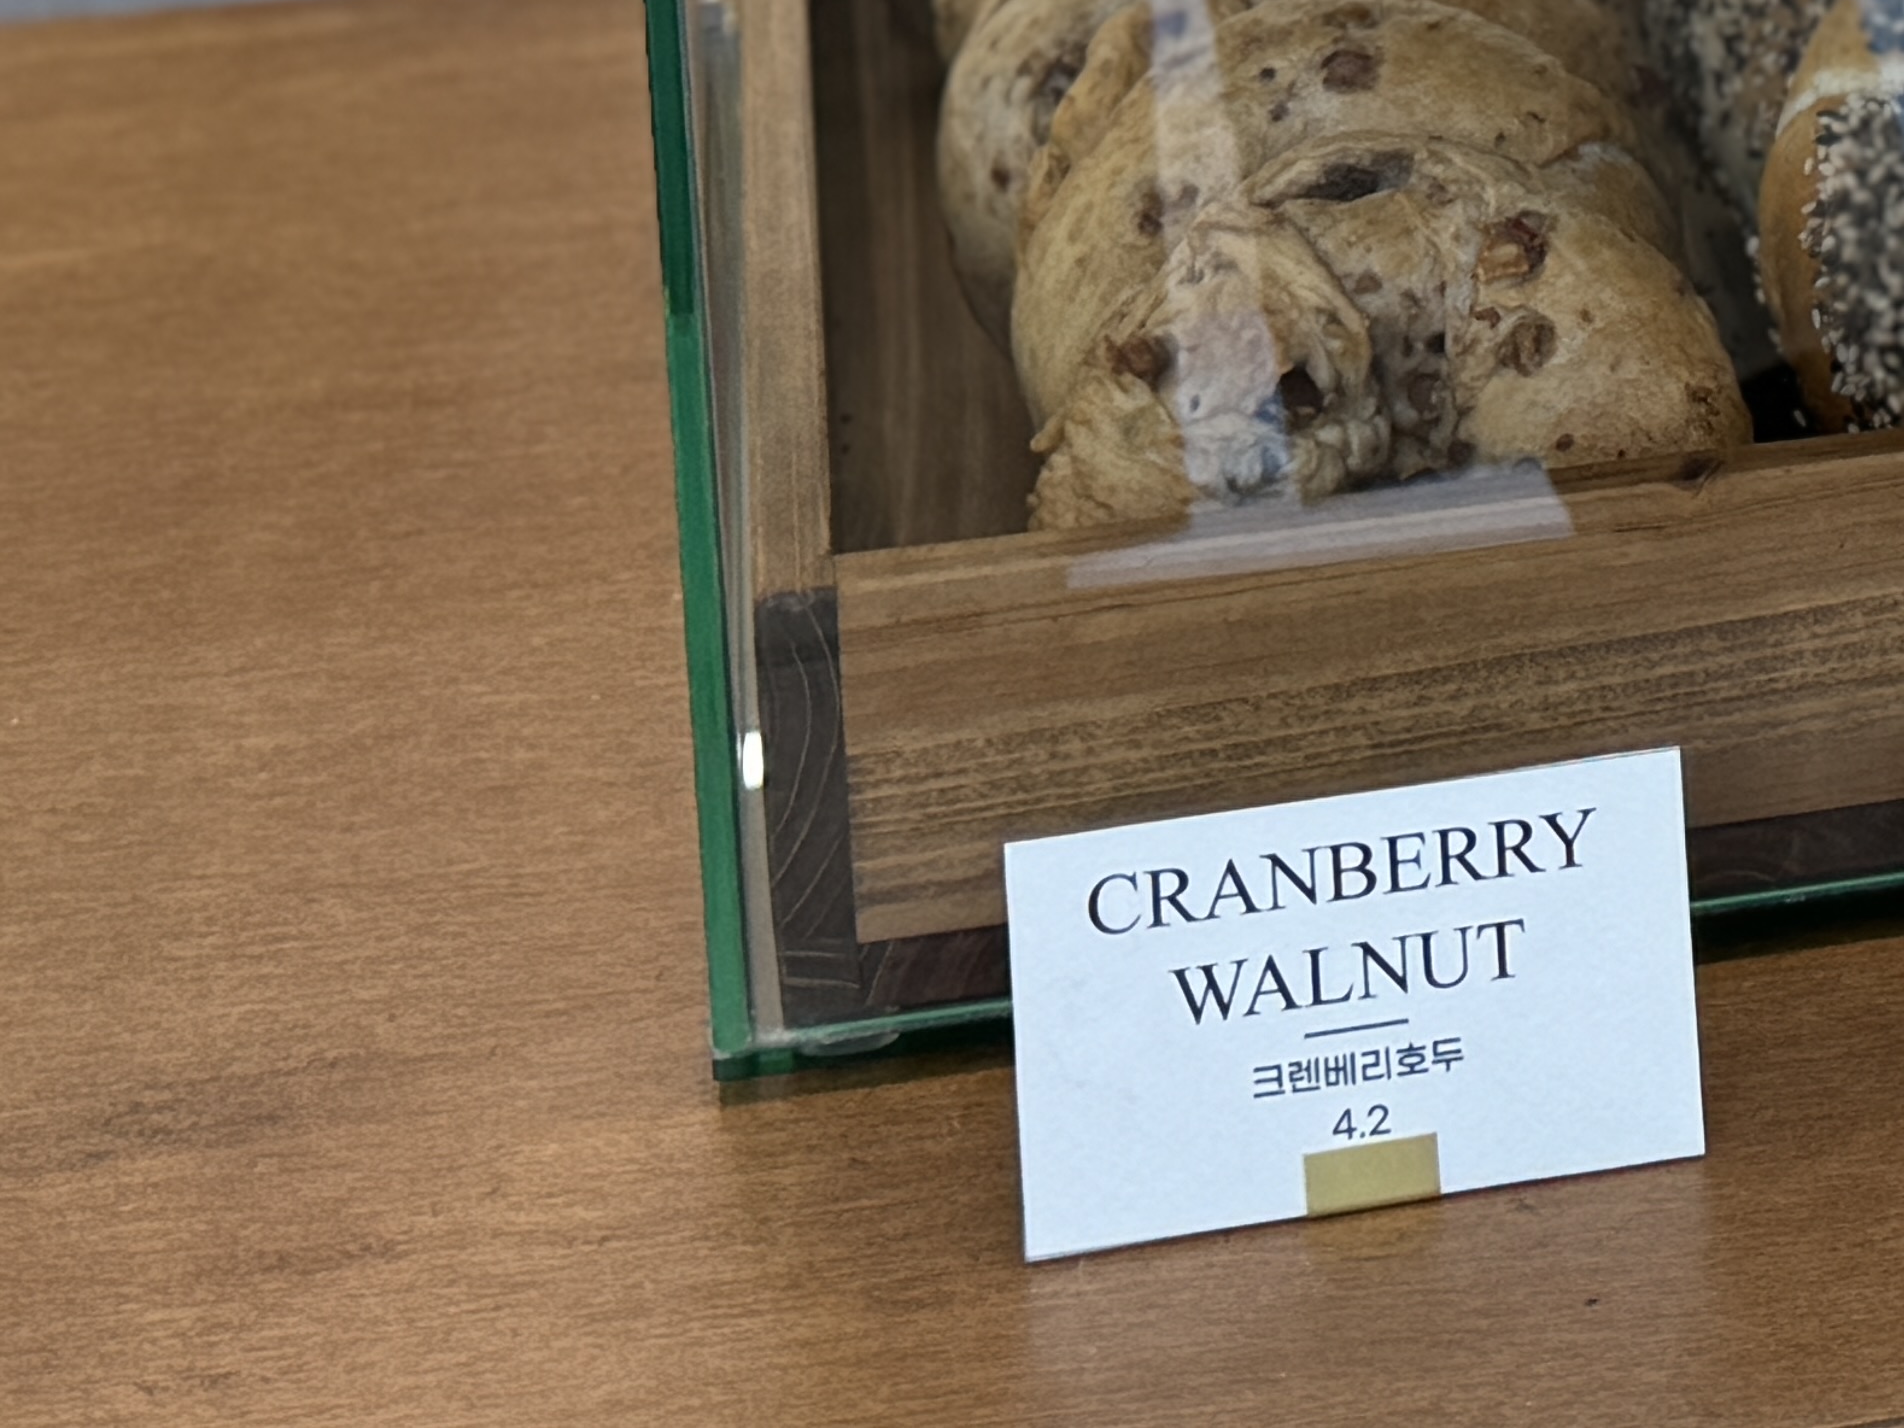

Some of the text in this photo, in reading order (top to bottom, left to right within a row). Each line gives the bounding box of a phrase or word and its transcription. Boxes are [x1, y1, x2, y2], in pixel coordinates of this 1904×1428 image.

[1087, 807, 1597, 935] CRANBERRY
[1168, 918, 1526, 1026] WALNUT
[1252, 1036, 1465, 1099] 크렌베리호두
[1331, 1104, 1392, 1140] 4.2
